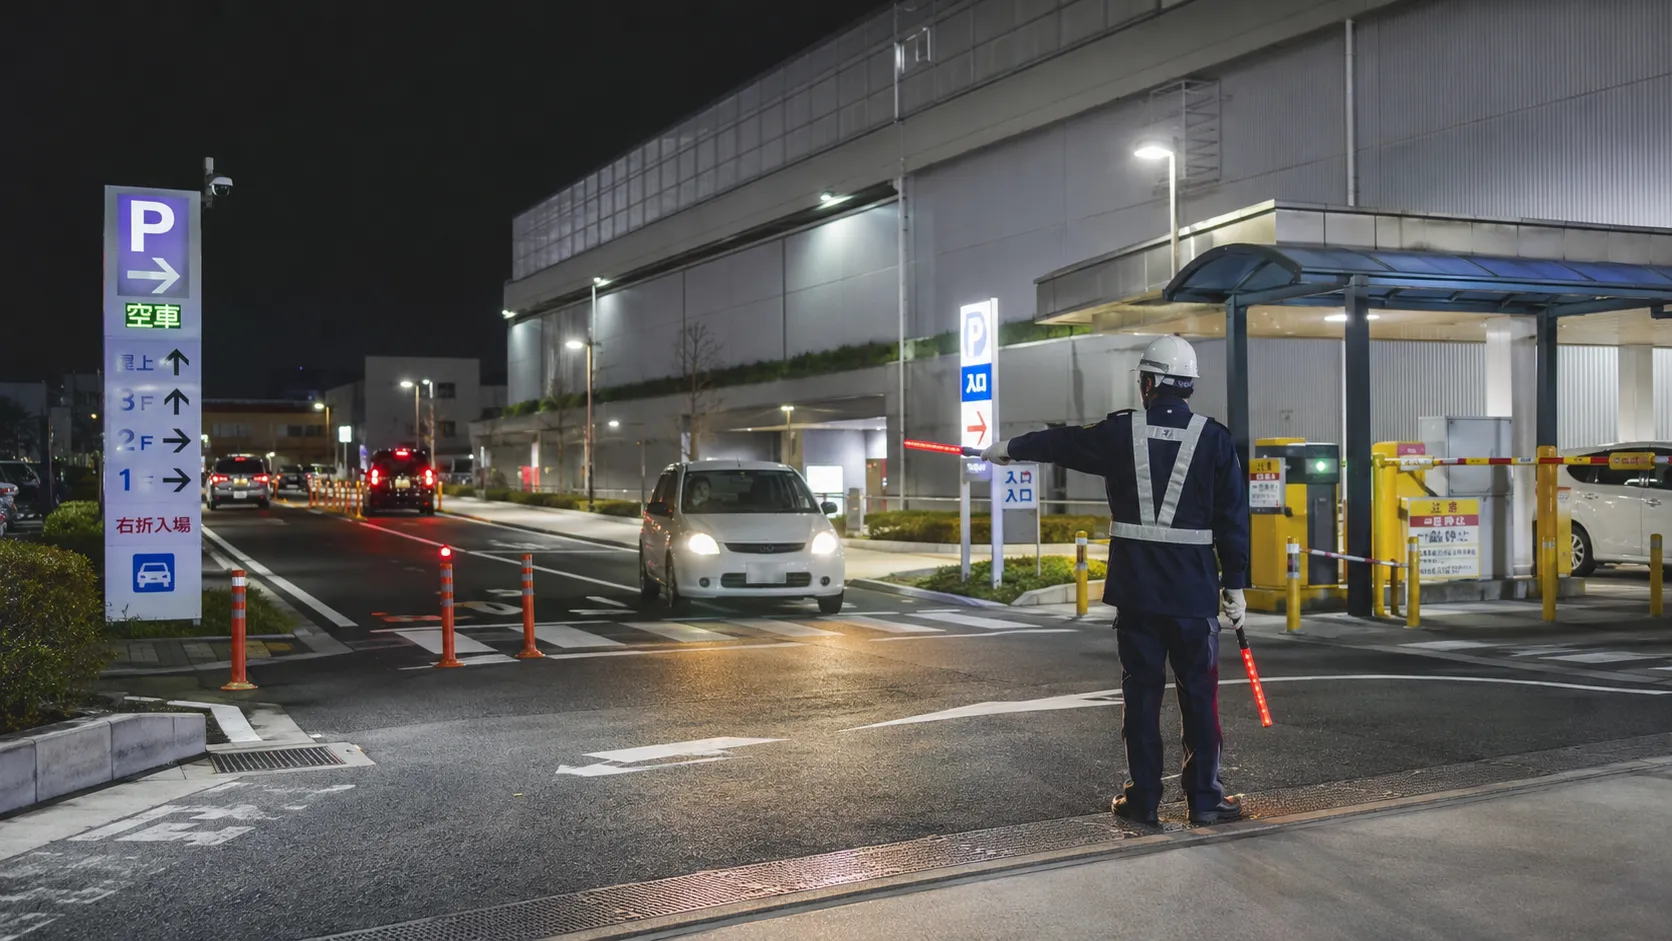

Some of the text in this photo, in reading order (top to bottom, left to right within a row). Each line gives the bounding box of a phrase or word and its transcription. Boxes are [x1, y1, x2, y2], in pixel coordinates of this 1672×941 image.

[130, 200, 175, 252] P
[126, 303, 180, 329] 空車
[968, 317, 984, 356] P
[966, 373, 987, 393] 入口
[1005, 470, 1032, 485] 入口
[1005, 489, 1032, 502] 入口
[116, 516, 191, 534] 右折入場
